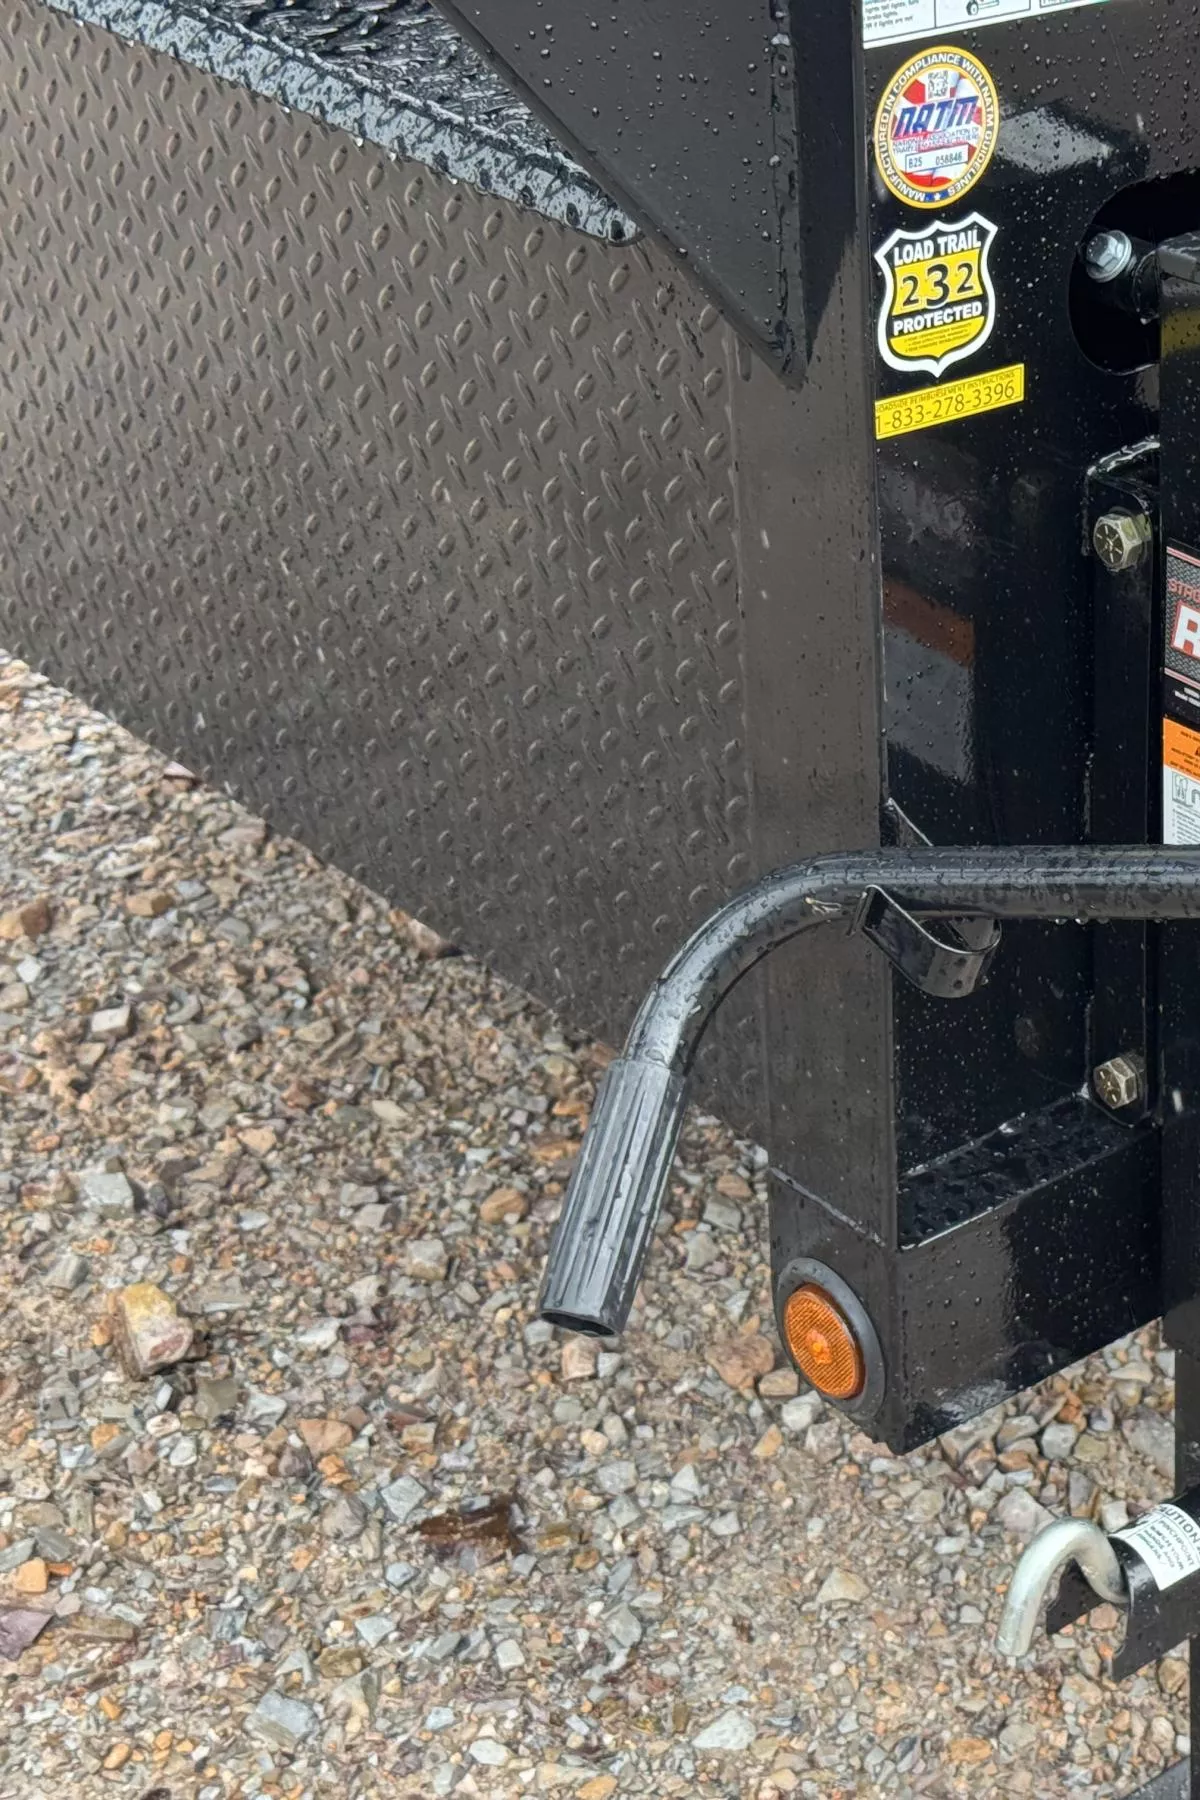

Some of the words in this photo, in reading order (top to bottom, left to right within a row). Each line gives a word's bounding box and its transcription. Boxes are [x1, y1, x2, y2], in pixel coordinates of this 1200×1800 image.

[884, 94, 895, 111] IN
[893, 53, 960, 94] COMPLIANCE
[962, 58, 987, 85] WITH
[982, 85, 994, 127] NATM
[893, 239, 935, 267] LOAD
[937, 229, 981, 256] TRAIL
[893, 301, 983, 336] PROTECTED
